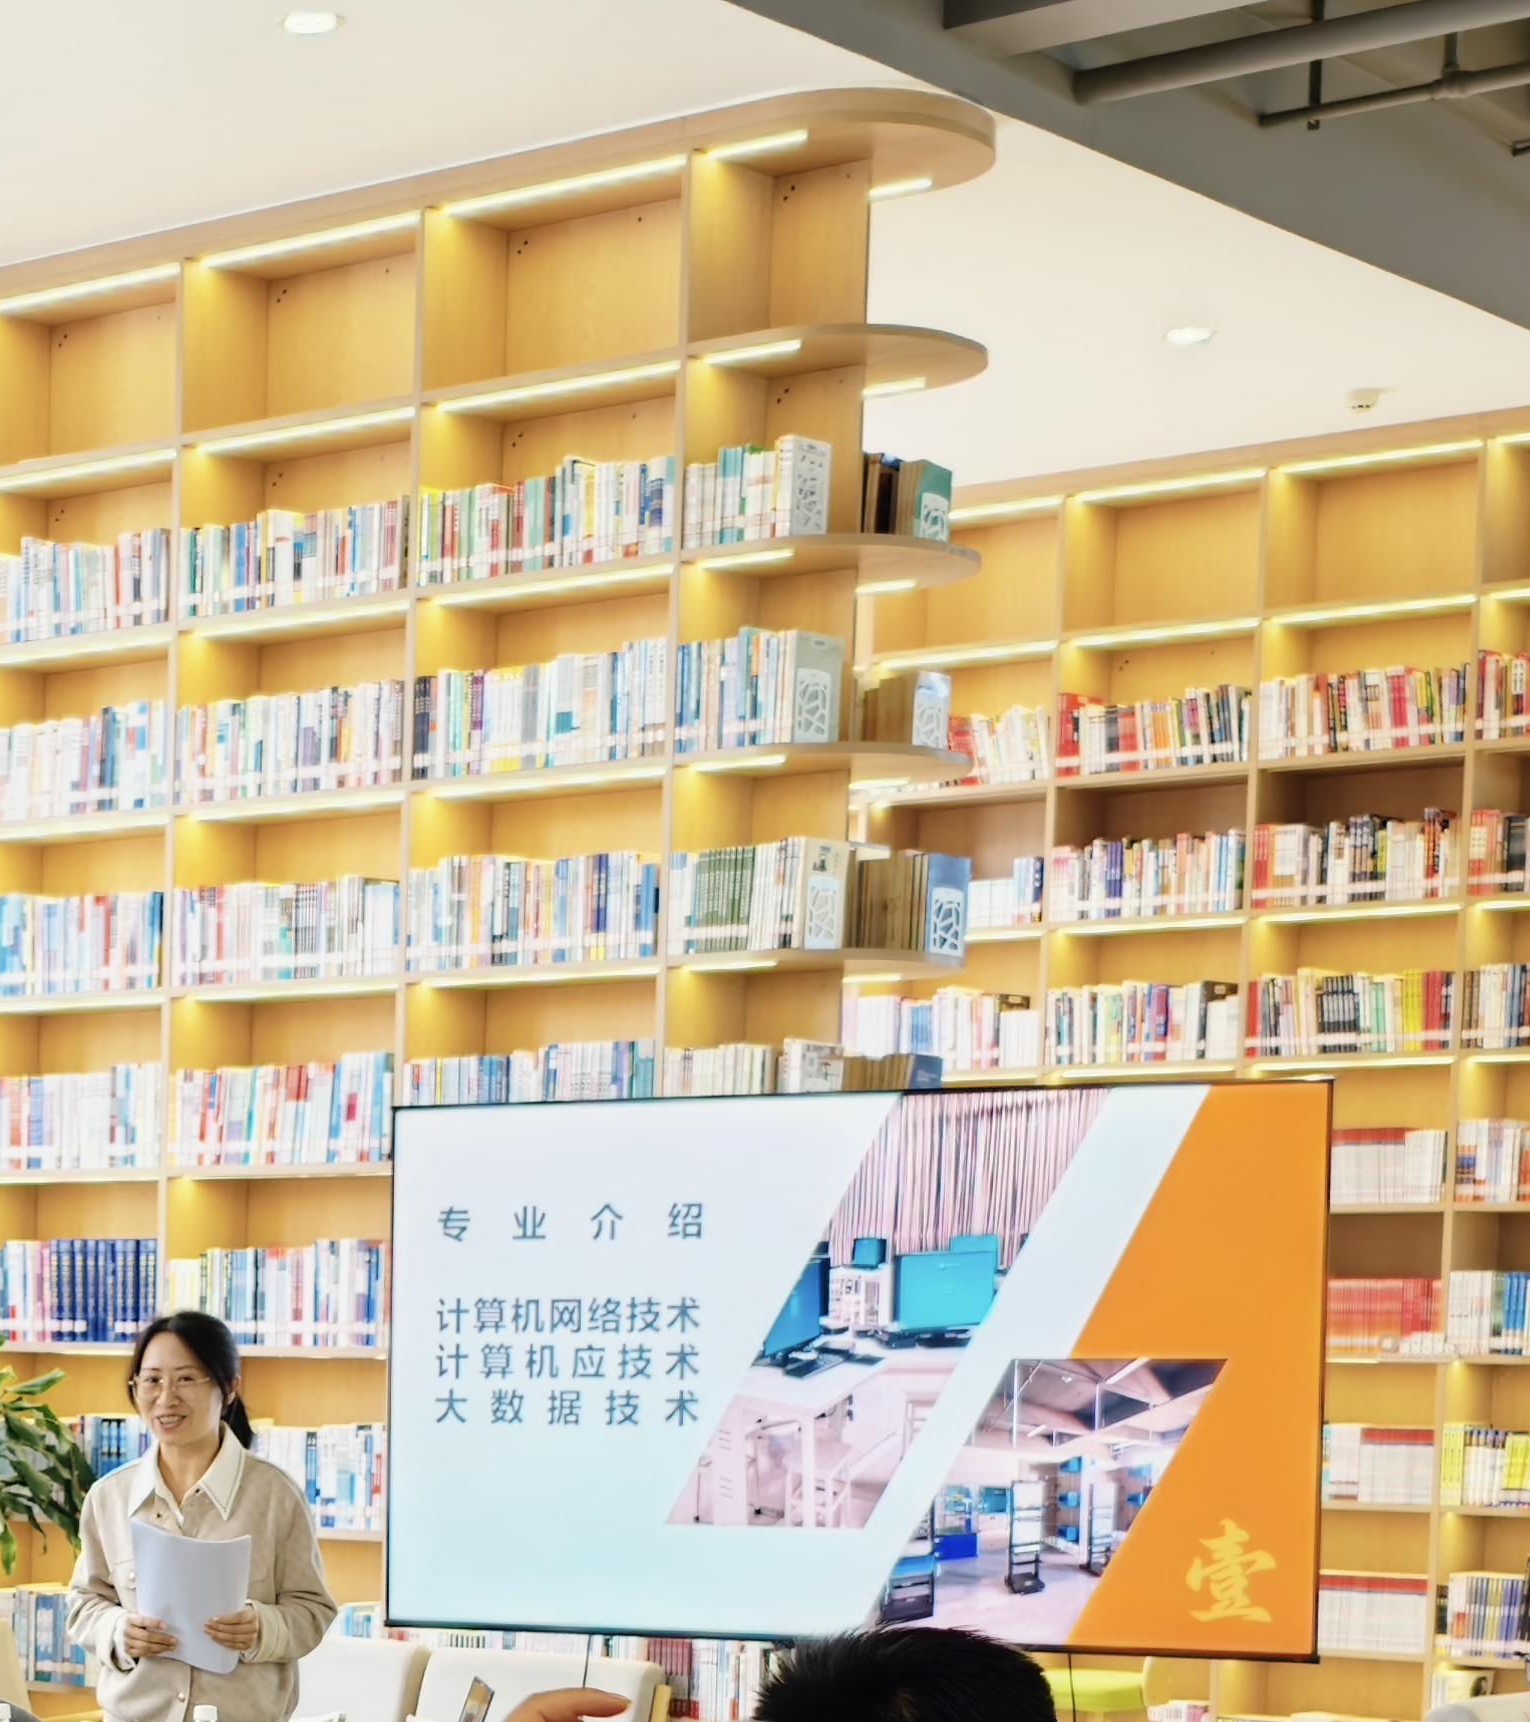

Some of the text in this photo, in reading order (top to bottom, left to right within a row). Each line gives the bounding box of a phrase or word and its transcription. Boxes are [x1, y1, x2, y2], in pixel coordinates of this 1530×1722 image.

[436, 1202, 705, 1242] 专业介绍
[435, 1297, 701, 1335] 计算机网络技术
[435, 1343, 700, 1380] 计算机应技术
[435, 1388, 700, 1428] 大数据技术
[1185, 1518, 1277, 1623] 壹
